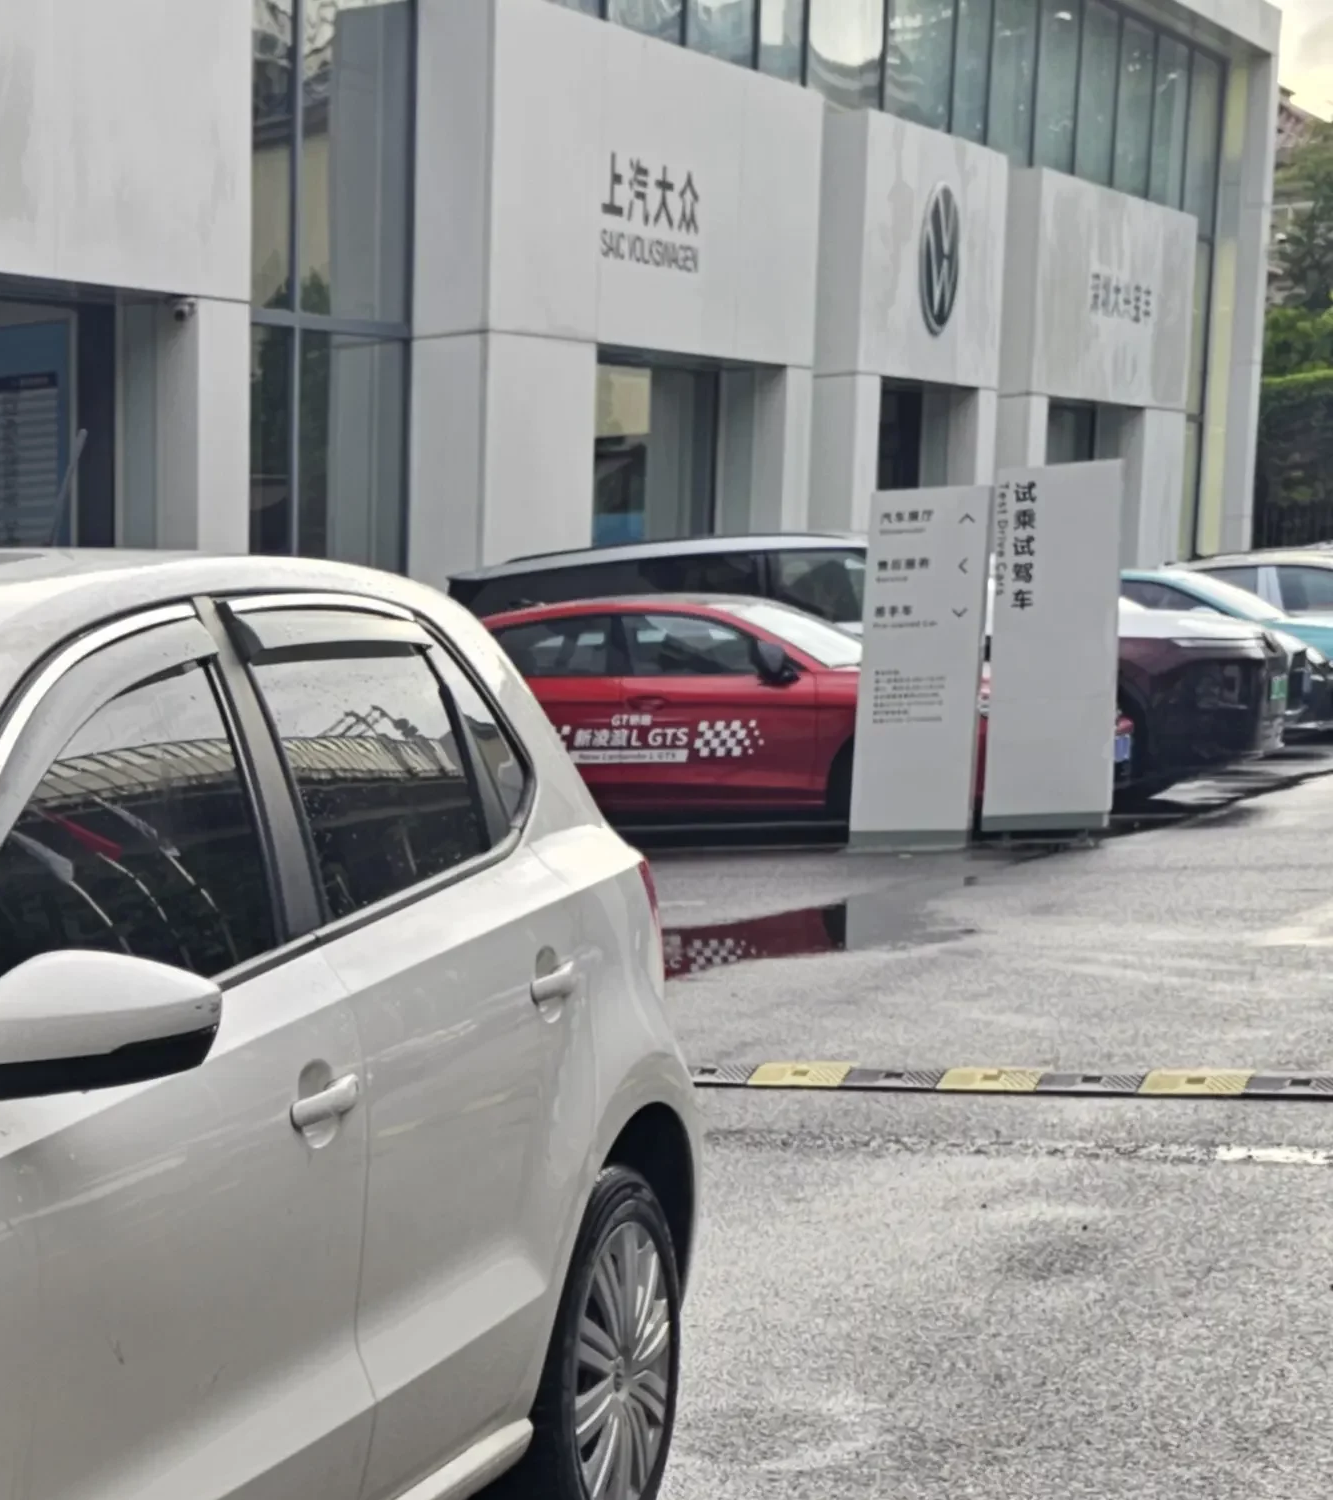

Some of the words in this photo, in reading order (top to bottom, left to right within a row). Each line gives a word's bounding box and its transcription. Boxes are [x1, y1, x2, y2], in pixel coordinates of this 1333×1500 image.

[600, 151, 699, 235] 上汽大众
[997, 481, 1010, 514] Test
[996, 519, 1009, 558] Drive
[1012, 481, 1037, 610] 试乘试驾车
[995, 562, 1008, 597] Cars
[647, 728, 689, 746] GTS
